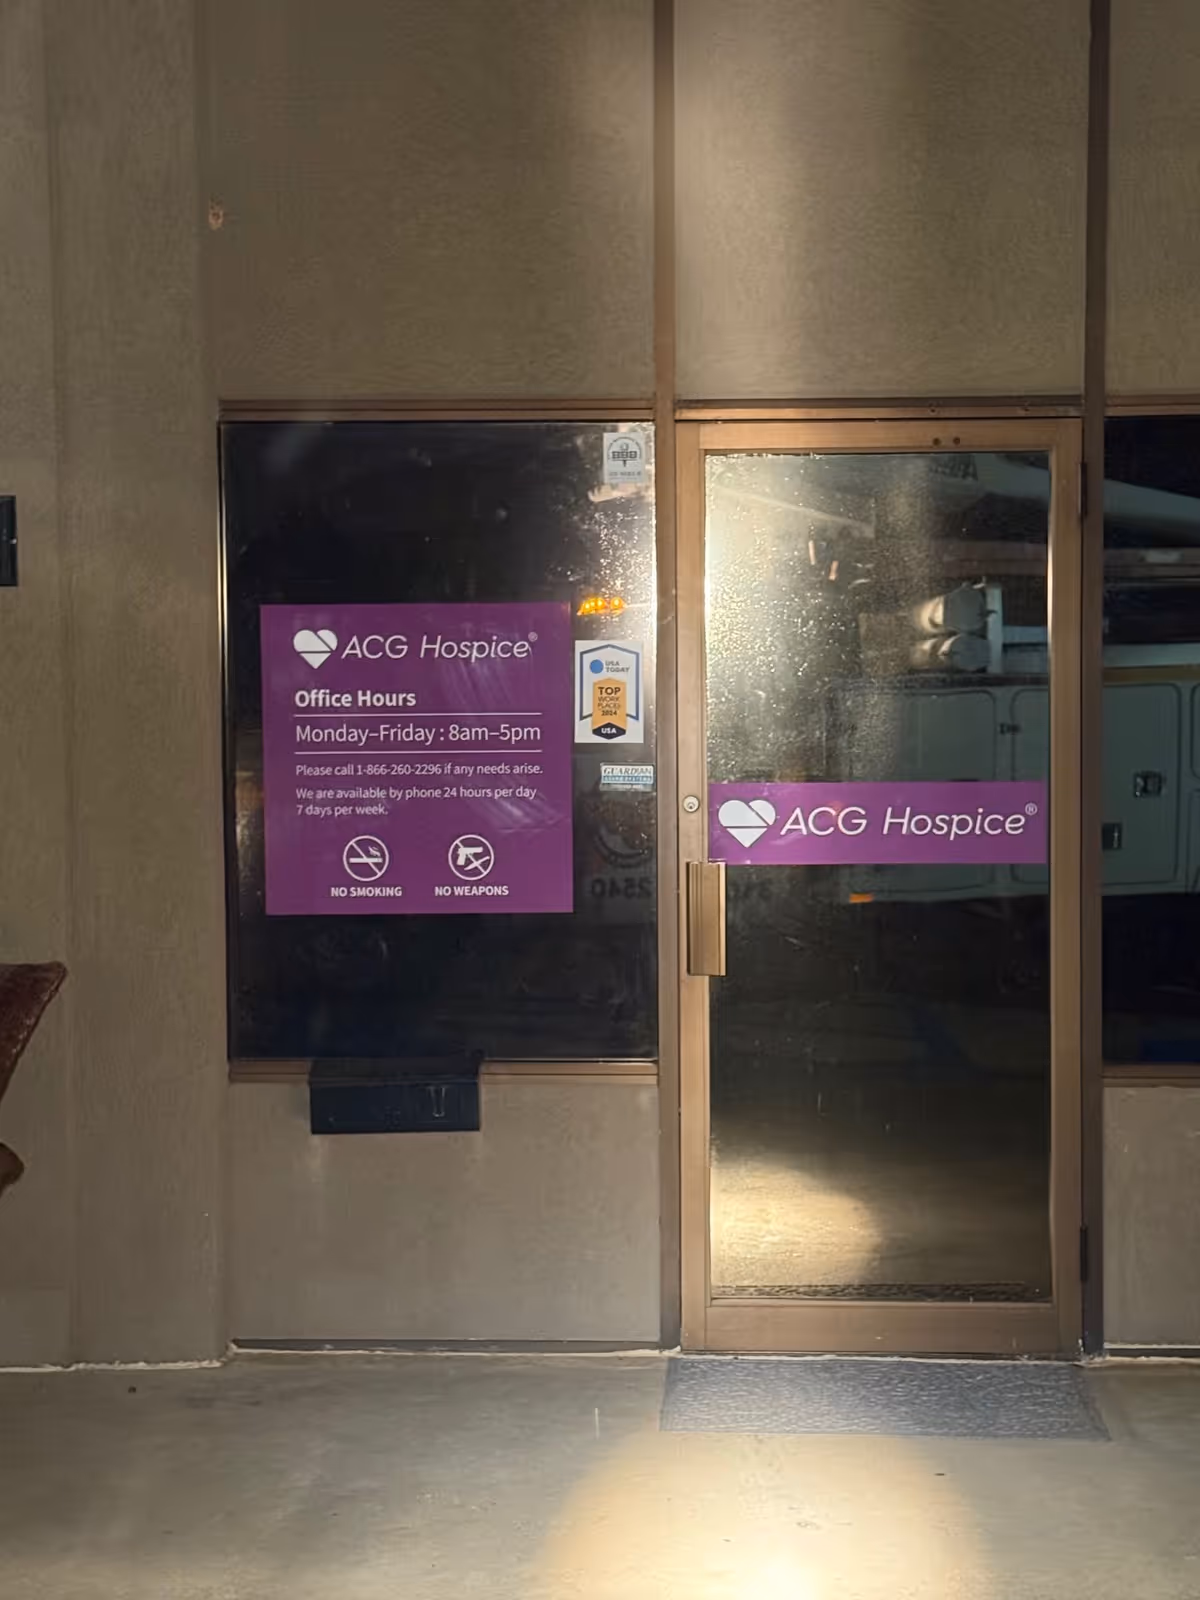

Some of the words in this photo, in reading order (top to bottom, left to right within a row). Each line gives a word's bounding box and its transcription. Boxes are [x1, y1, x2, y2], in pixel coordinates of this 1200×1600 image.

[341, 635, 408, 659] ACG
[295, 689, 353, 707] Office
[357, 690, 417, 707] Hours
[598, 687, 620, 695] TOP
[296, 765, 333, 775] Please
[334, 764, 354, 775] call
[357, 764, 441, 775] 1-866-260-2296
[444, 763, 451, 774] if
[453, 765, 474, 777] any
[477, 763, 511, 774] needs
[513, 764, 543, 774] arise.
[296, 788, 314, 799] We
[316, 790, 334, 799] are
[337, 787, 387, 799] available
[389, 787, 403, 800] by
[405, 787, 442, 800] phone
[443, 788, 457, 798] 24
[460, 787, 492, 798] hours
[494, 789, 513, 800] per
[516, 786, 537, 799] day
[296, 805, 303, 815] 7
[305, 804, 332, 818] days
[334, 806, 353, 817] per
[355, 804, 388, 815] week.
[780, 806, 867, 836] ACG
[331, 887, 347, 897] NO
[350, 886, 402, 897] SMOKING
[435, 886, 451, 896] NO
[453, 886, 509, 896] WEAPONS
